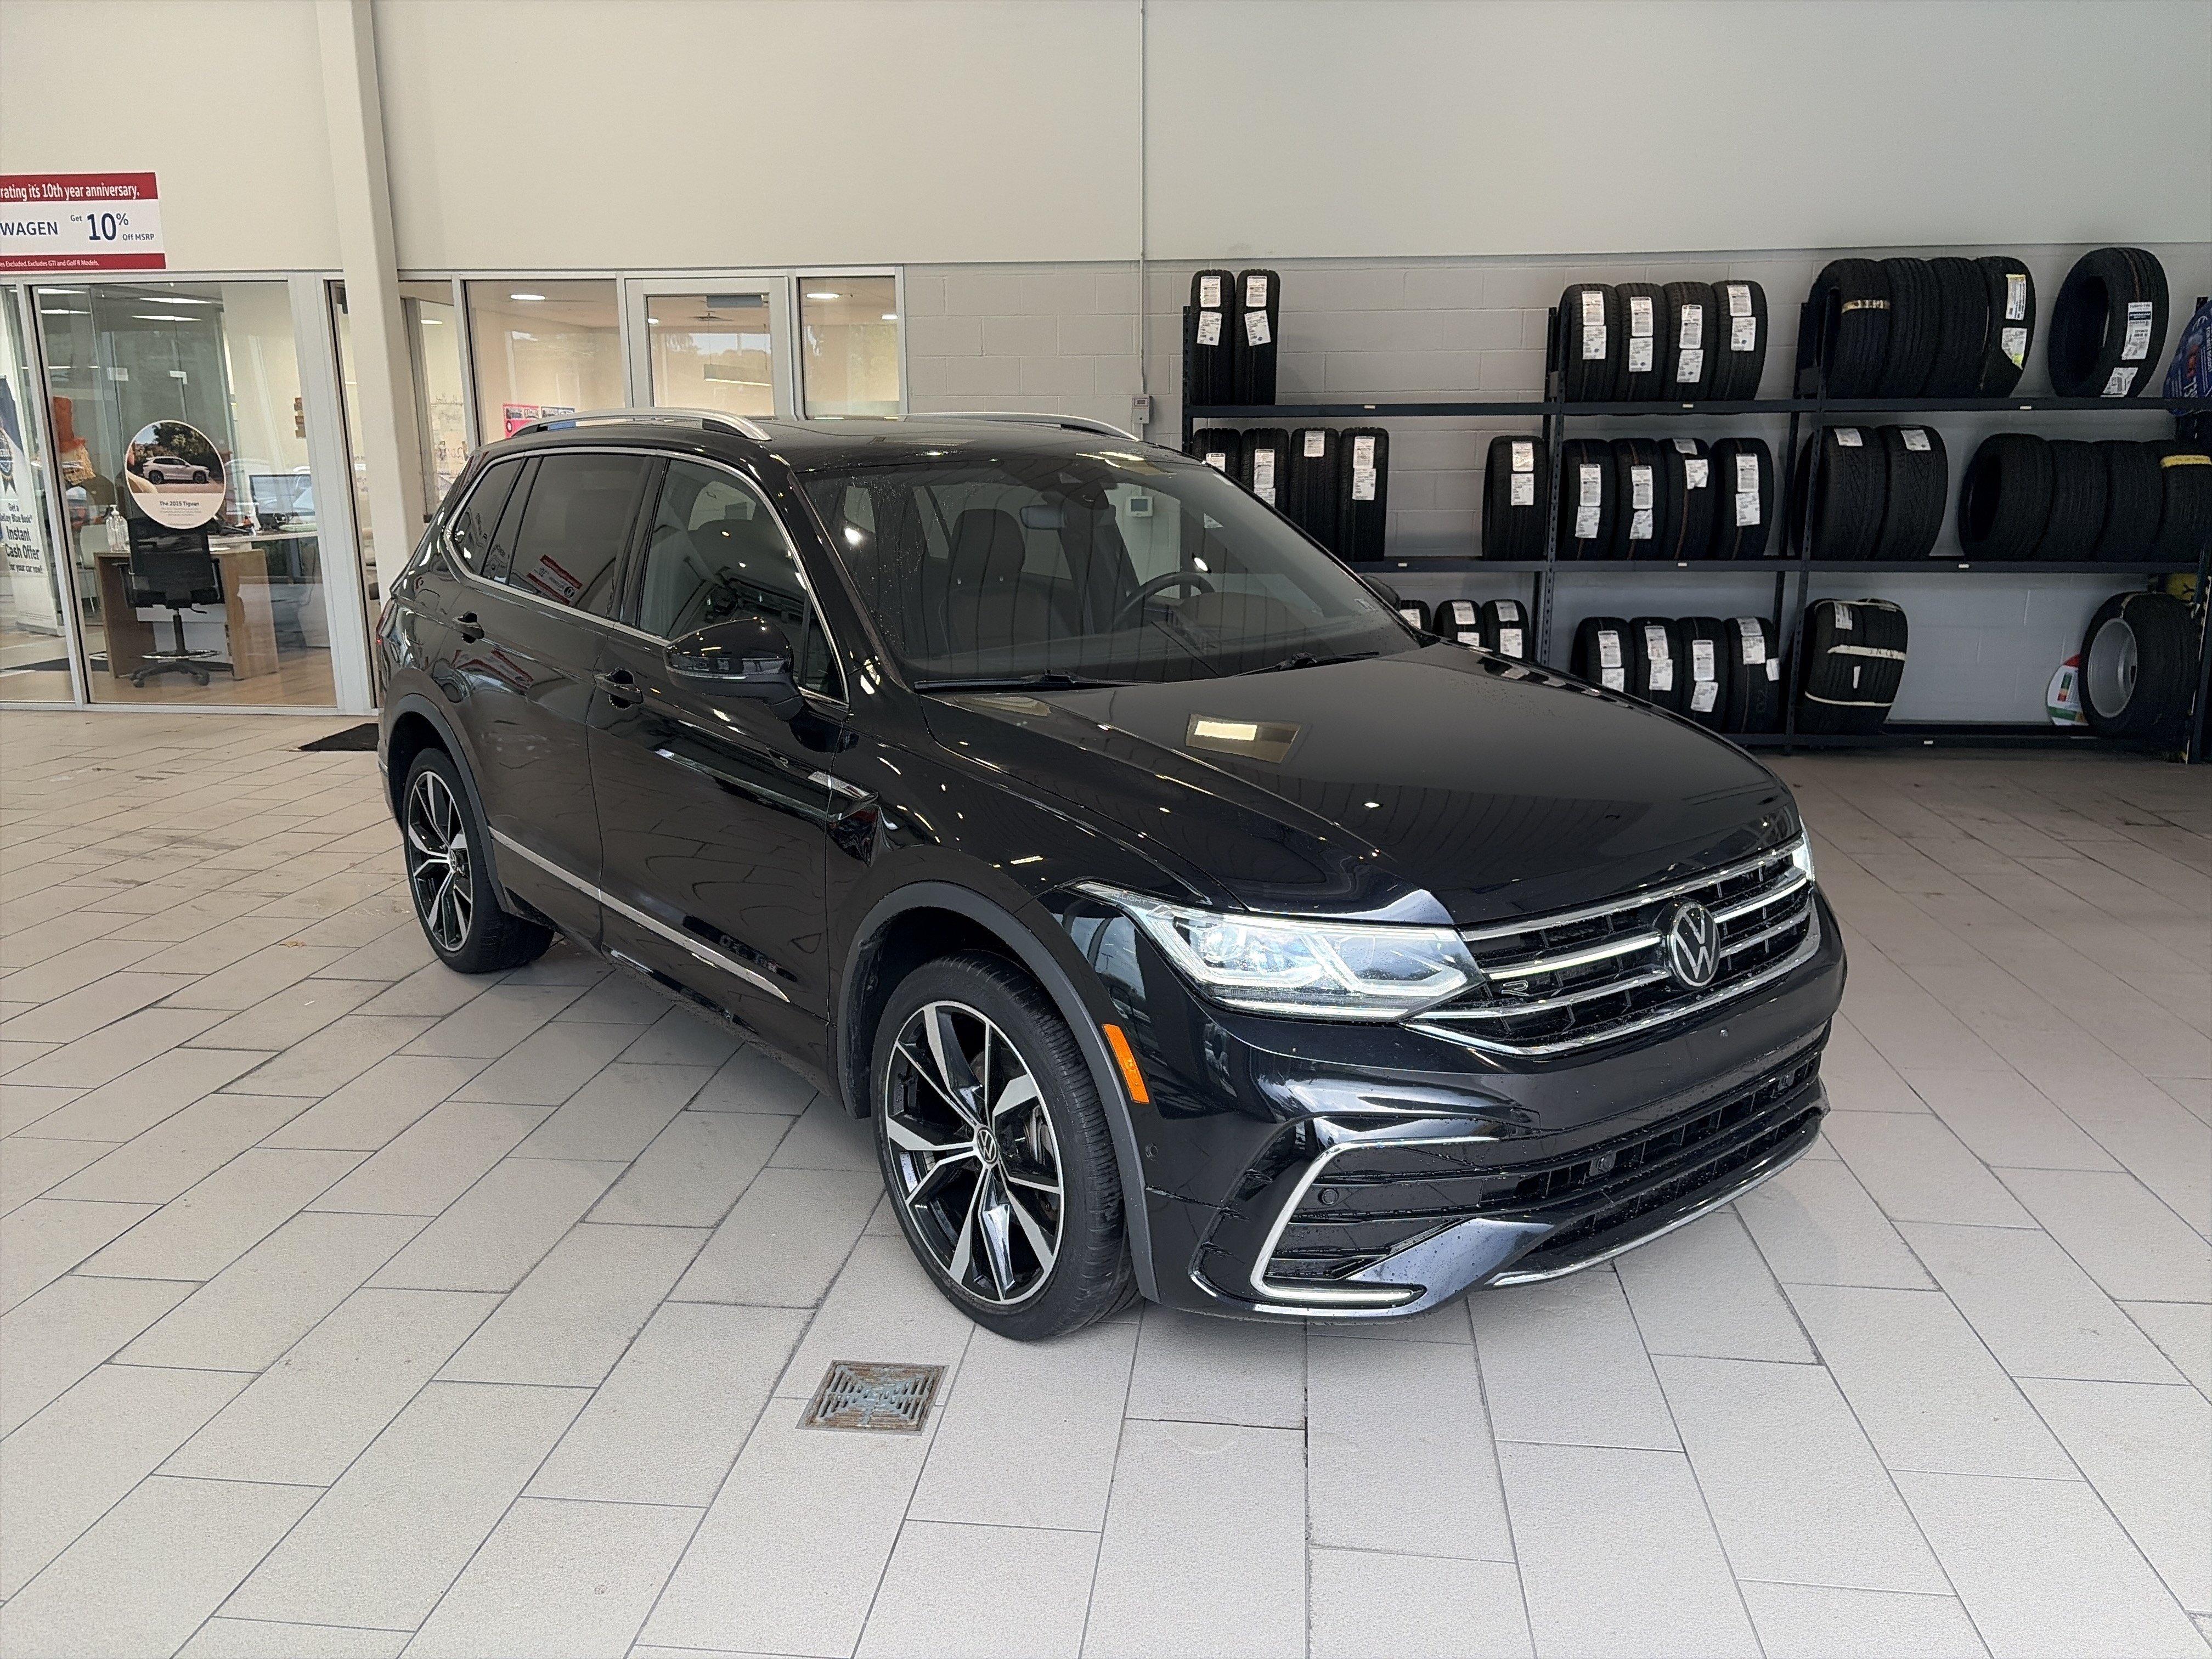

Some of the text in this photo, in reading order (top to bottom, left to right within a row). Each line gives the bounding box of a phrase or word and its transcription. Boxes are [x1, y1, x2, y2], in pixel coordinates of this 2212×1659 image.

[0, 184, 27, 201] rating
[42, 183, 64, 198] 10th
[64, 187, 83, 201] year
[86, 182, 140, 200] anniversary.
[0, 222, 58, 236] WAGEN
[6, 526, 31, 541] Instant
[5, 543, 40, 560] Cash Offer
